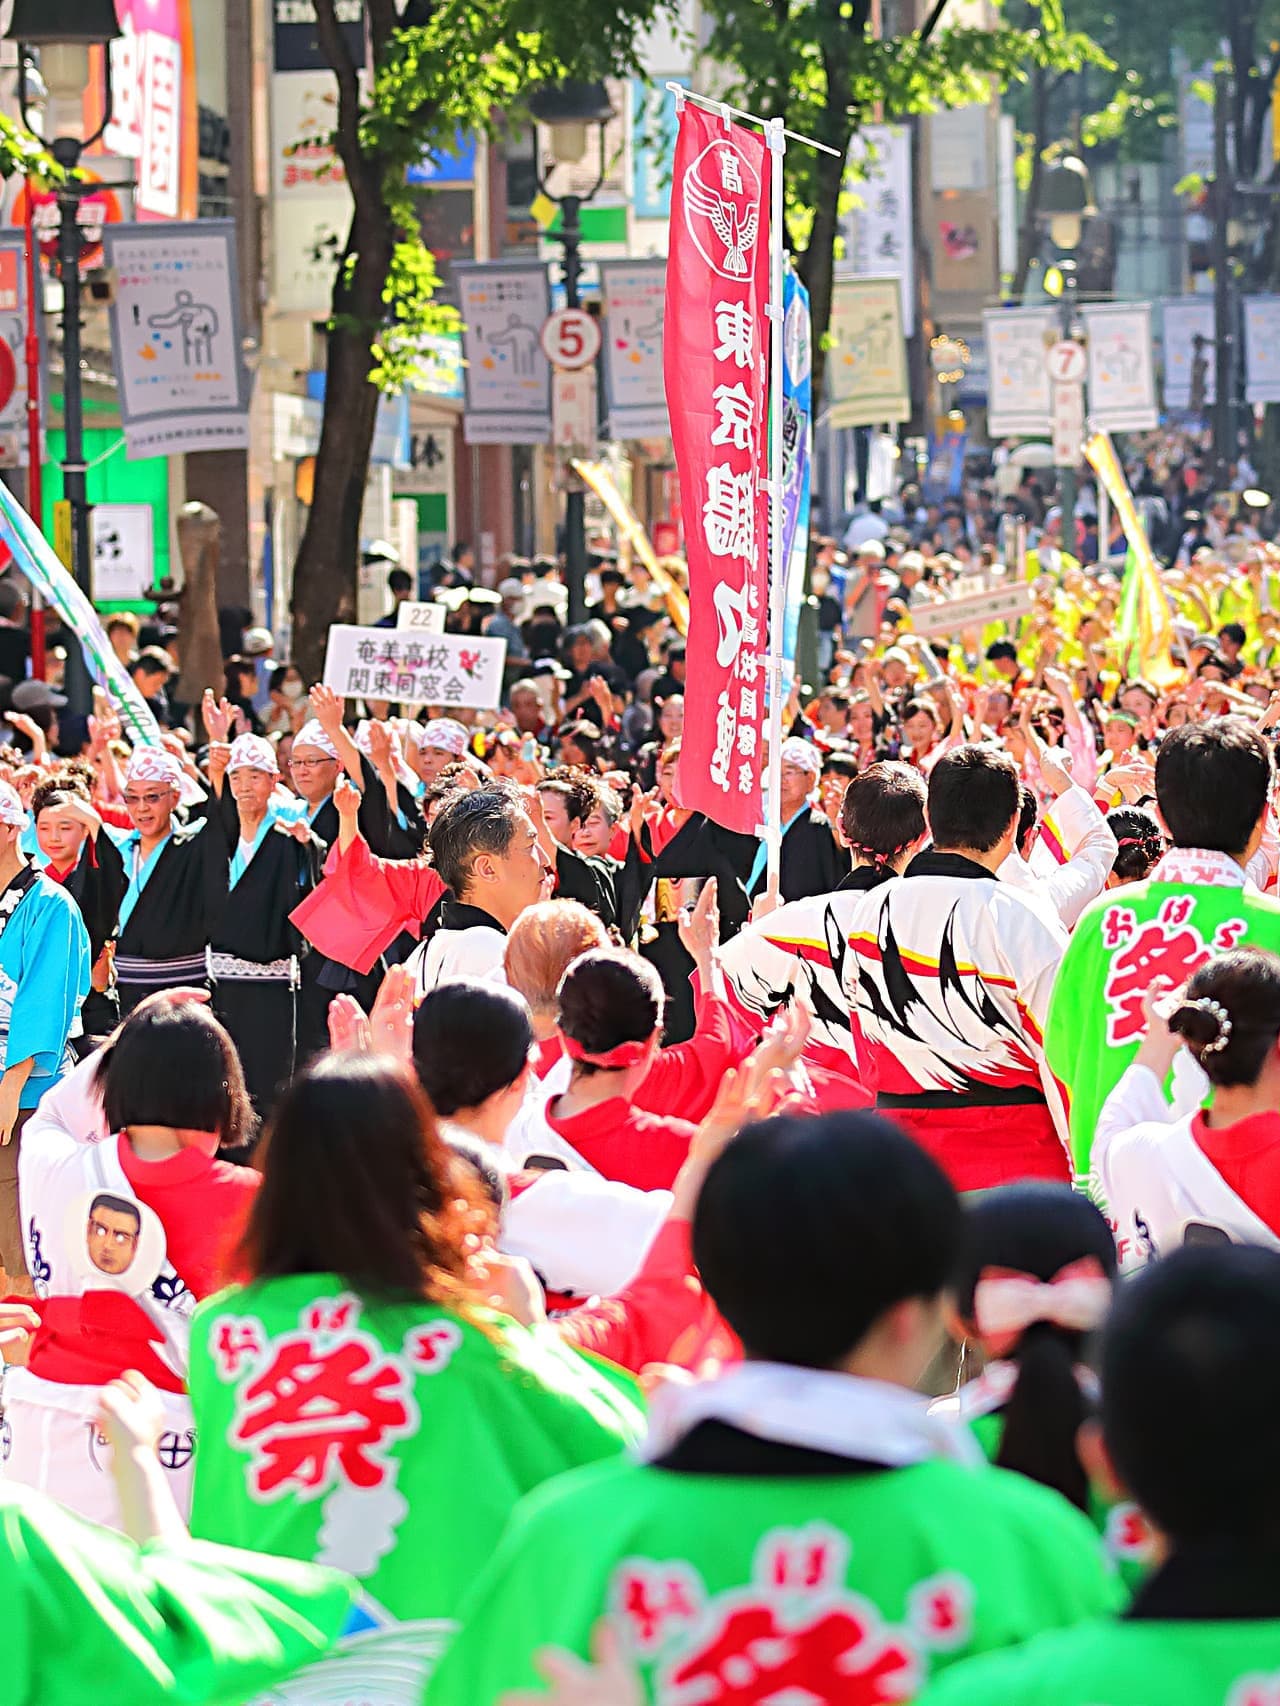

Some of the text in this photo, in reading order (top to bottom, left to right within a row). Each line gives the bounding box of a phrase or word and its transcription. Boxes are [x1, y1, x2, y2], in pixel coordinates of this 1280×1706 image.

[560, 320, 584, 357] 5
[1058, 350, 1076, 373] 7
[409, 608, 433, 627] 22
[357, 637, 450, 671] 奄美高校
[347, 667, 466, 702] 関東同窓会
[236, 1340, 408, 1493] 祭
